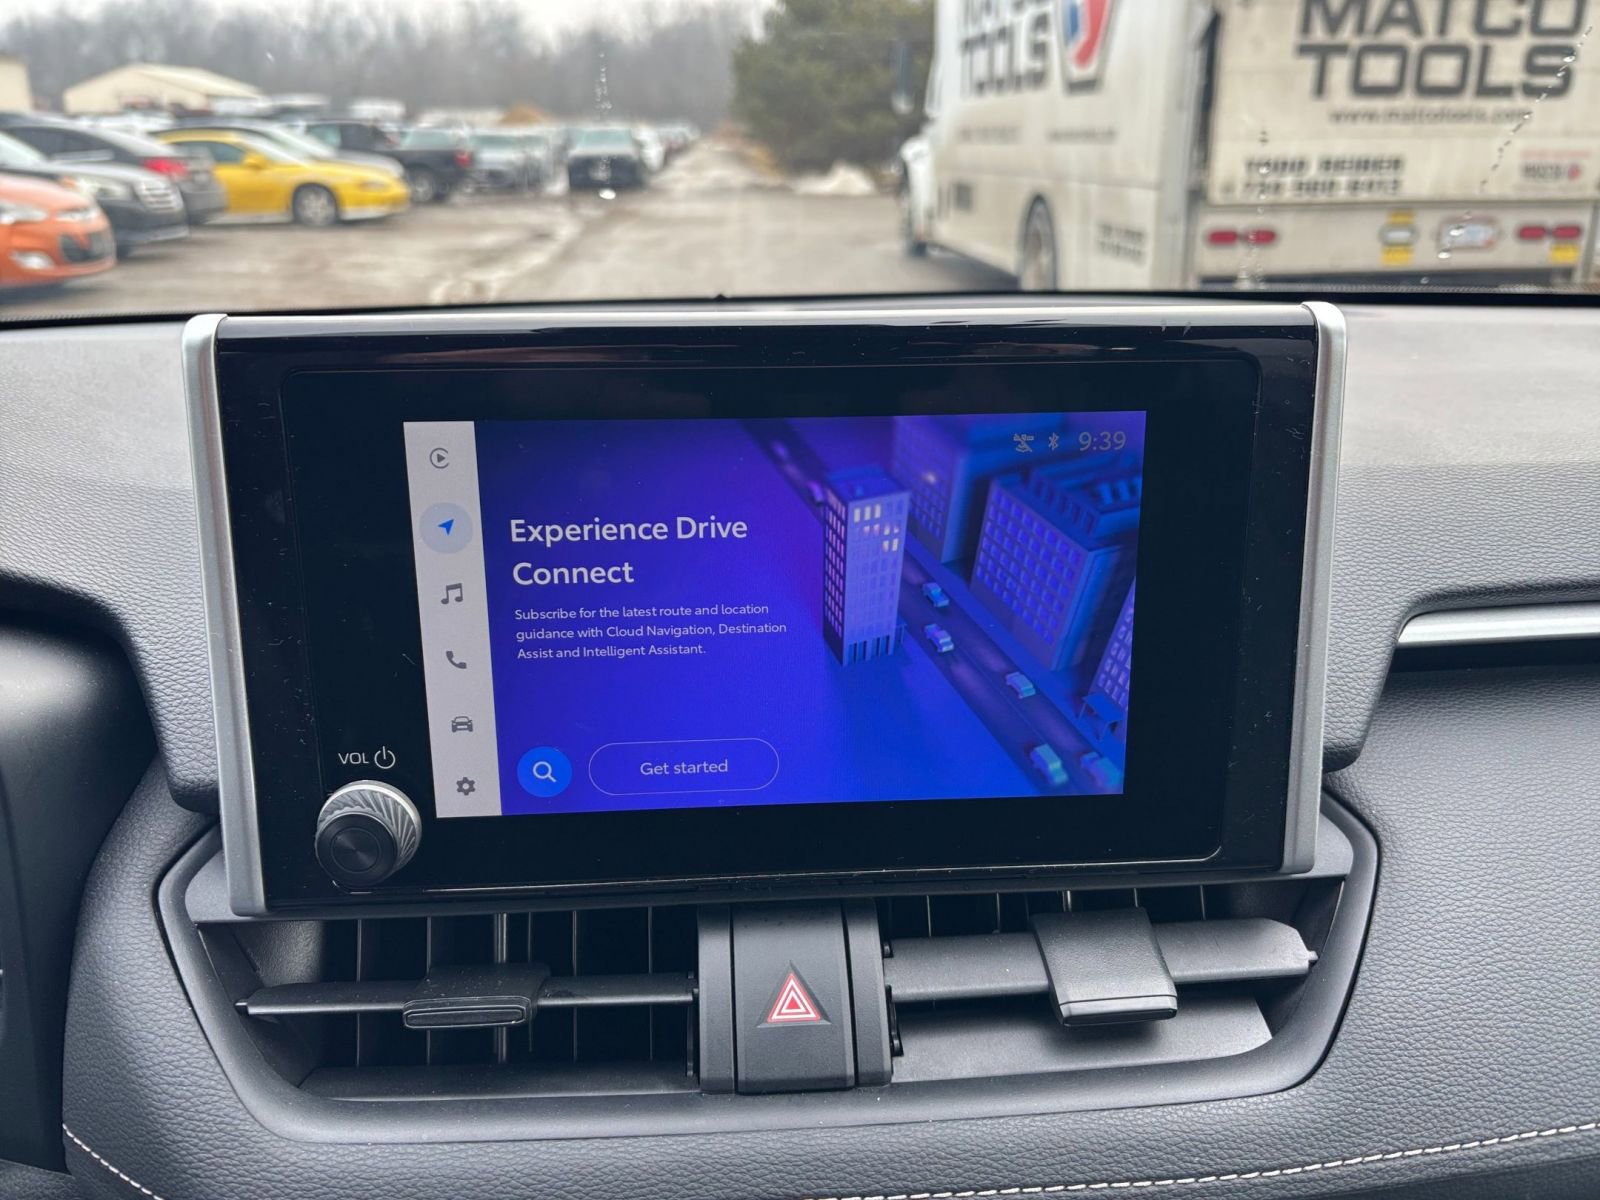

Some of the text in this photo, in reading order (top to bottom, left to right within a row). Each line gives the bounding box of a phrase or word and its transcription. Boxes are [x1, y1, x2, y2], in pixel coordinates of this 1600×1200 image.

[1296, 42, 1577, 98] TOOLS
[1078, 431, 1127, 451] 9:39
[510, 515, 748, 548] Experience Drive
[512, 561, 635, 586] Connect
[514, 603, 769, 620] Subscribe for the latest route and location
[516, 622, 787, 642] guidance with Cloud Navigation, Destination
[517, 643, 706, 660] Assist and Intelligent Assistant.
[338, 752, 369, 765] VOL
[640, 759, 728, 775] Get started
